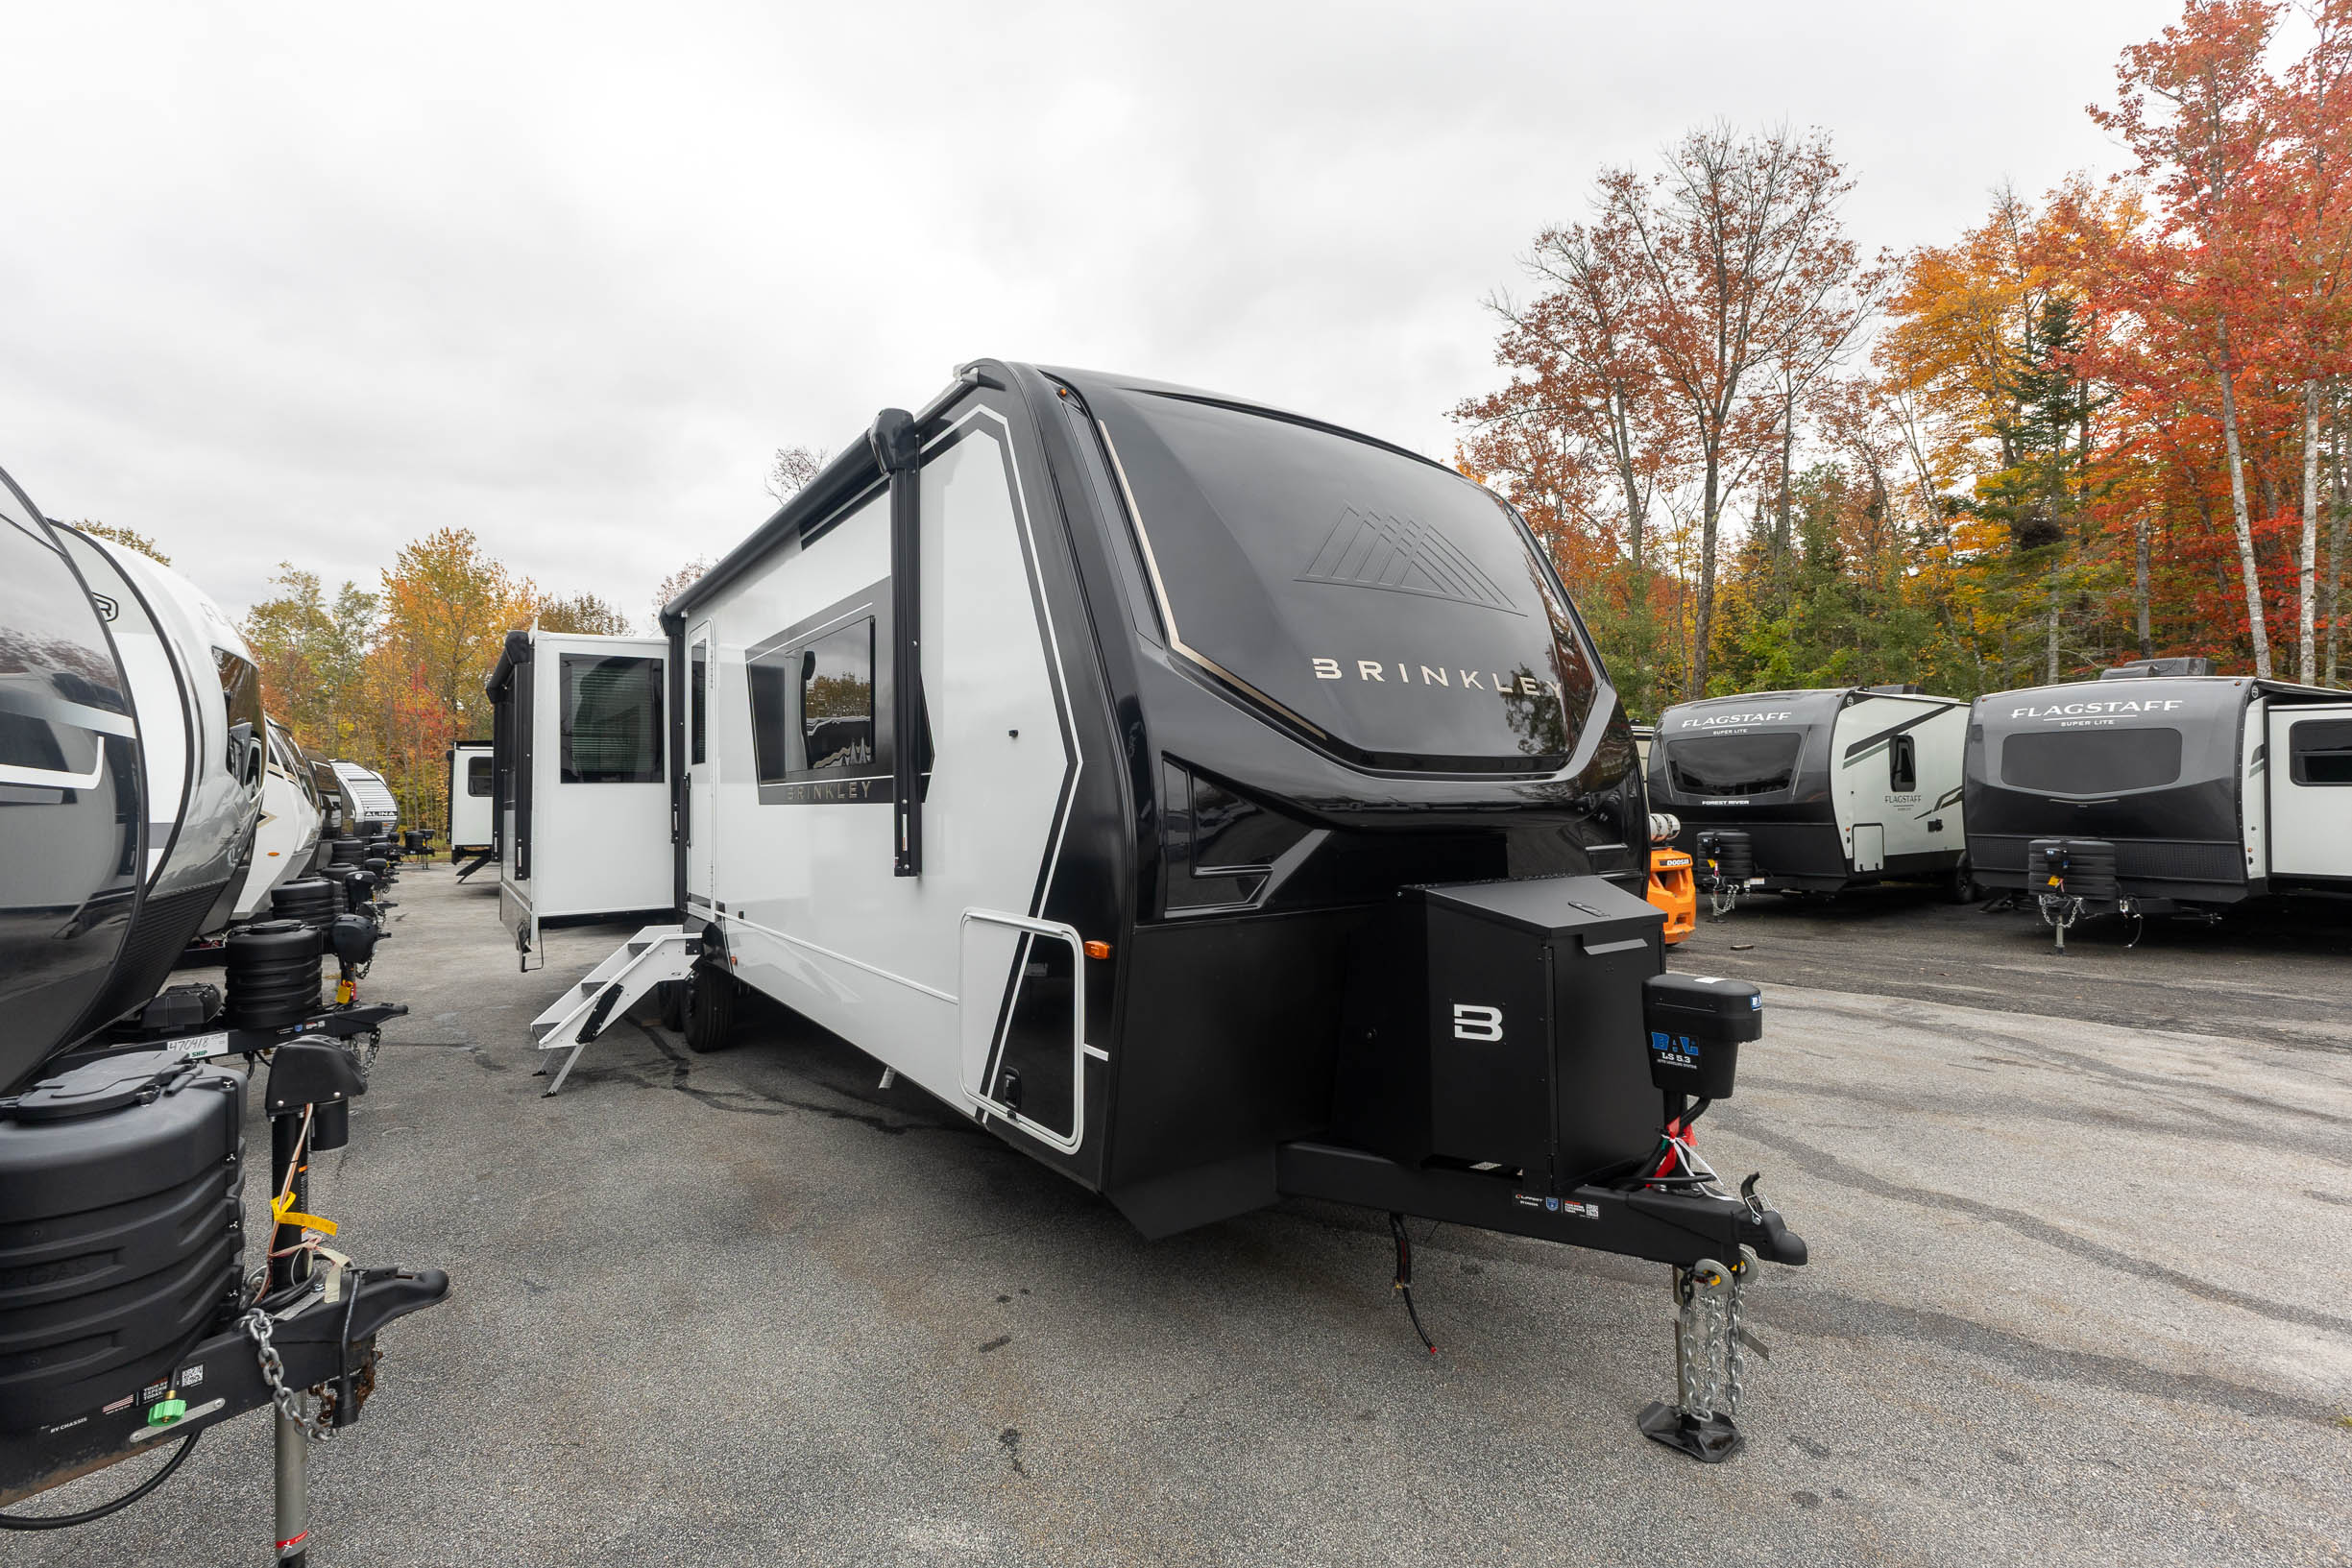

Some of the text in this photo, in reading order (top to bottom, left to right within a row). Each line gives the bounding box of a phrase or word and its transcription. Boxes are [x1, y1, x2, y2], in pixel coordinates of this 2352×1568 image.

[1312, 658, 1563, 699] BRINKLEY
[2010, 700, 2183, 719] FLAGSTAFF
[1682, 712, 1792, 729] FLAGSTAFF
[787, 781, 872, 800] BRINKLEY
[1884, 794, 1922, 804] FLAGSTAFF
[191, 1049, 207, 1058] SHIP
[1661, 1052, 1675, 1061] LS
